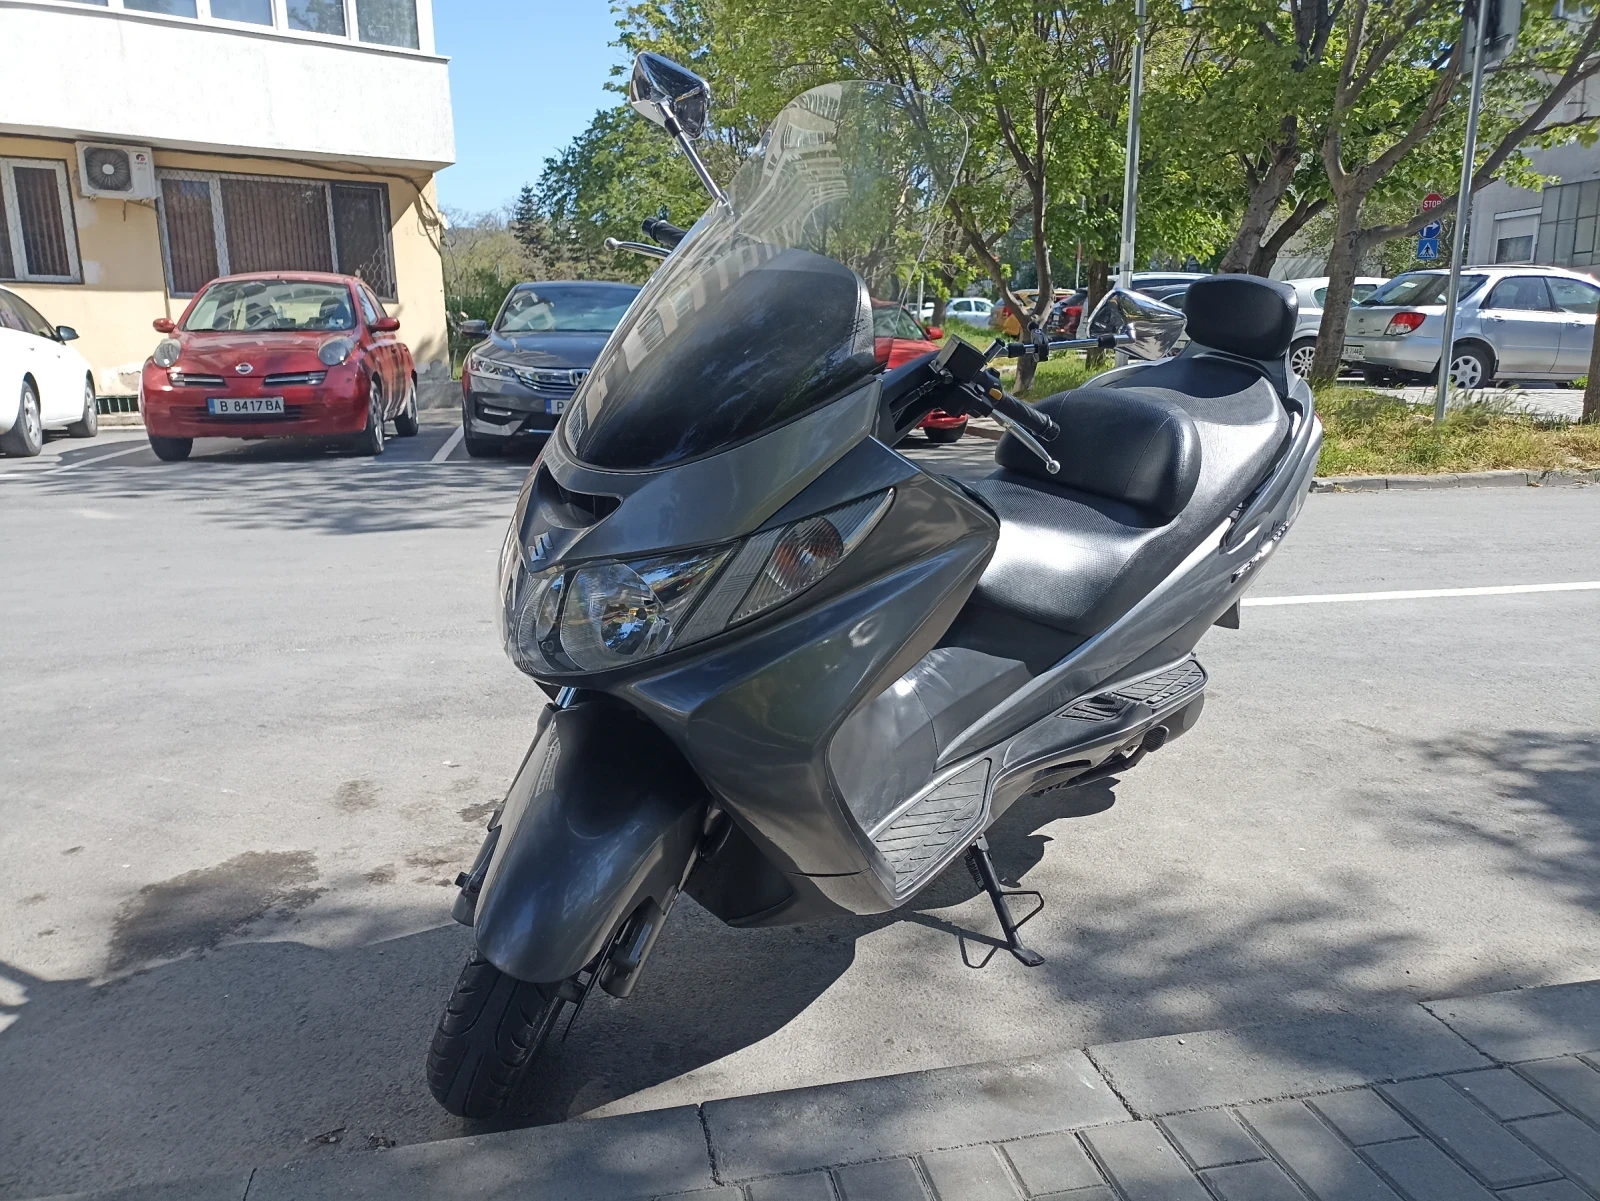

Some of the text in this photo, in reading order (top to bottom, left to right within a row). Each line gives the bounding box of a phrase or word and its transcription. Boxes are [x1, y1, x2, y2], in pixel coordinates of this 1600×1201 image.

[220, 400, 282, 411] B 8417 BA
[557, 401, 564, 412] P
